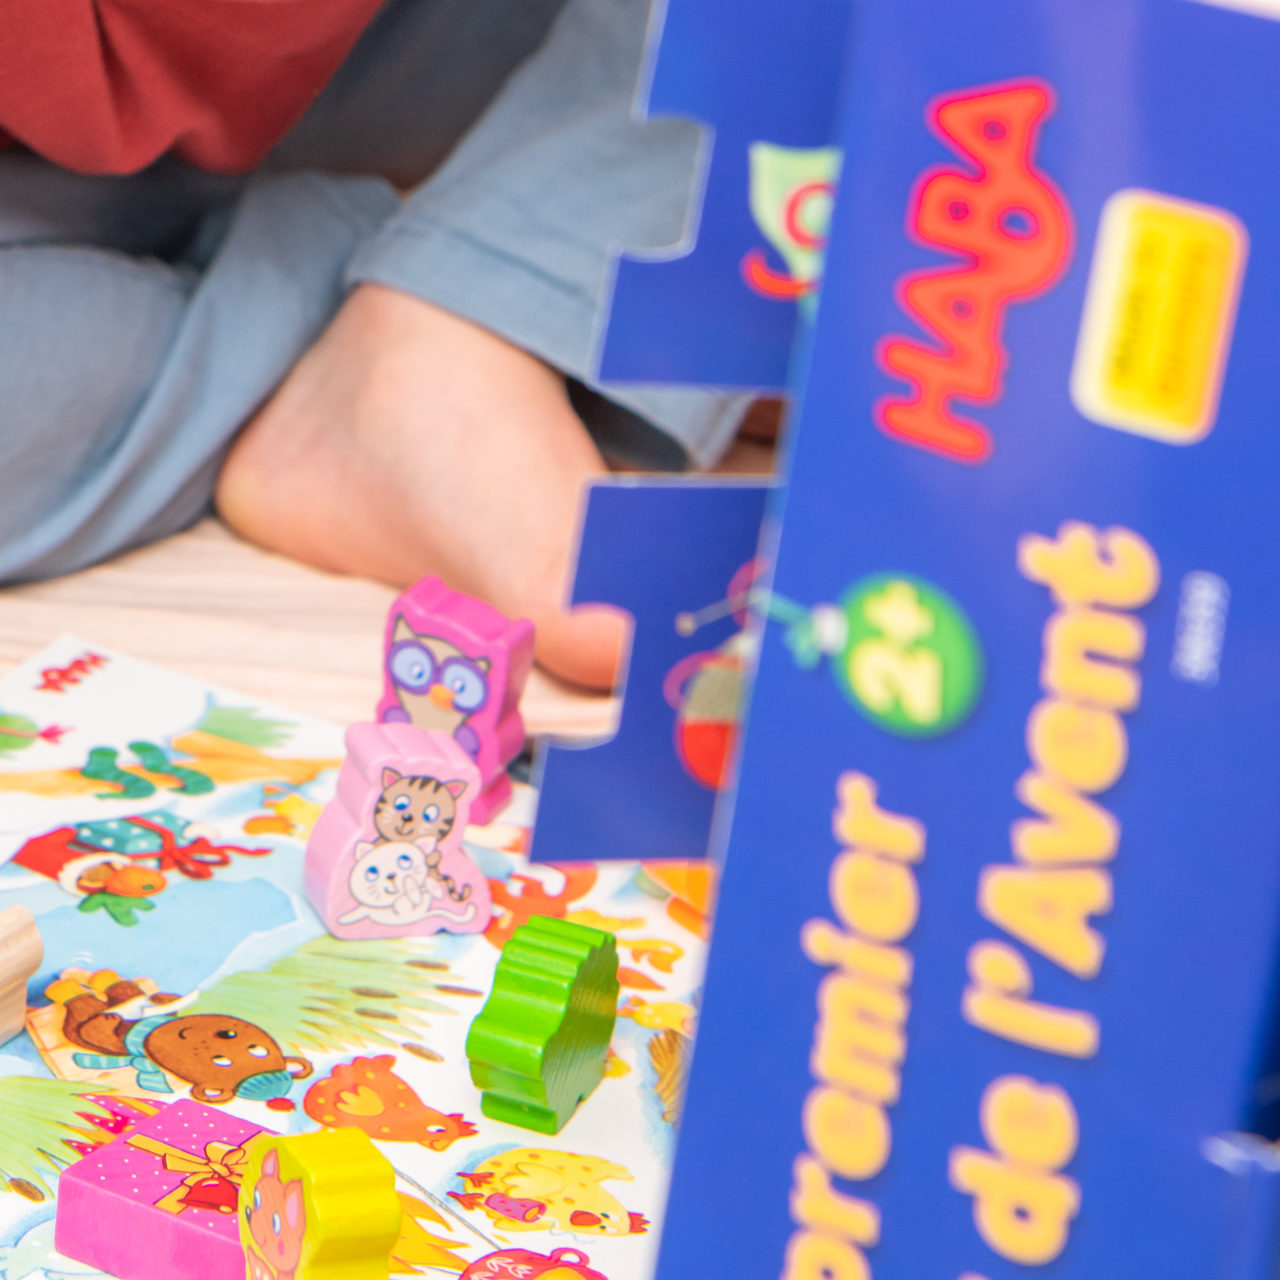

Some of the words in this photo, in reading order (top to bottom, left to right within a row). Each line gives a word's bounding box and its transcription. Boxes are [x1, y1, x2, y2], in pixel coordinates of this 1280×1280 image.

[873, 77, 1076, 465] HABA
[847, 579, 944, 725] 2+
[962, 521, 1160, 1058] l'Avent
[950, 1076, 1079, 1266] de
